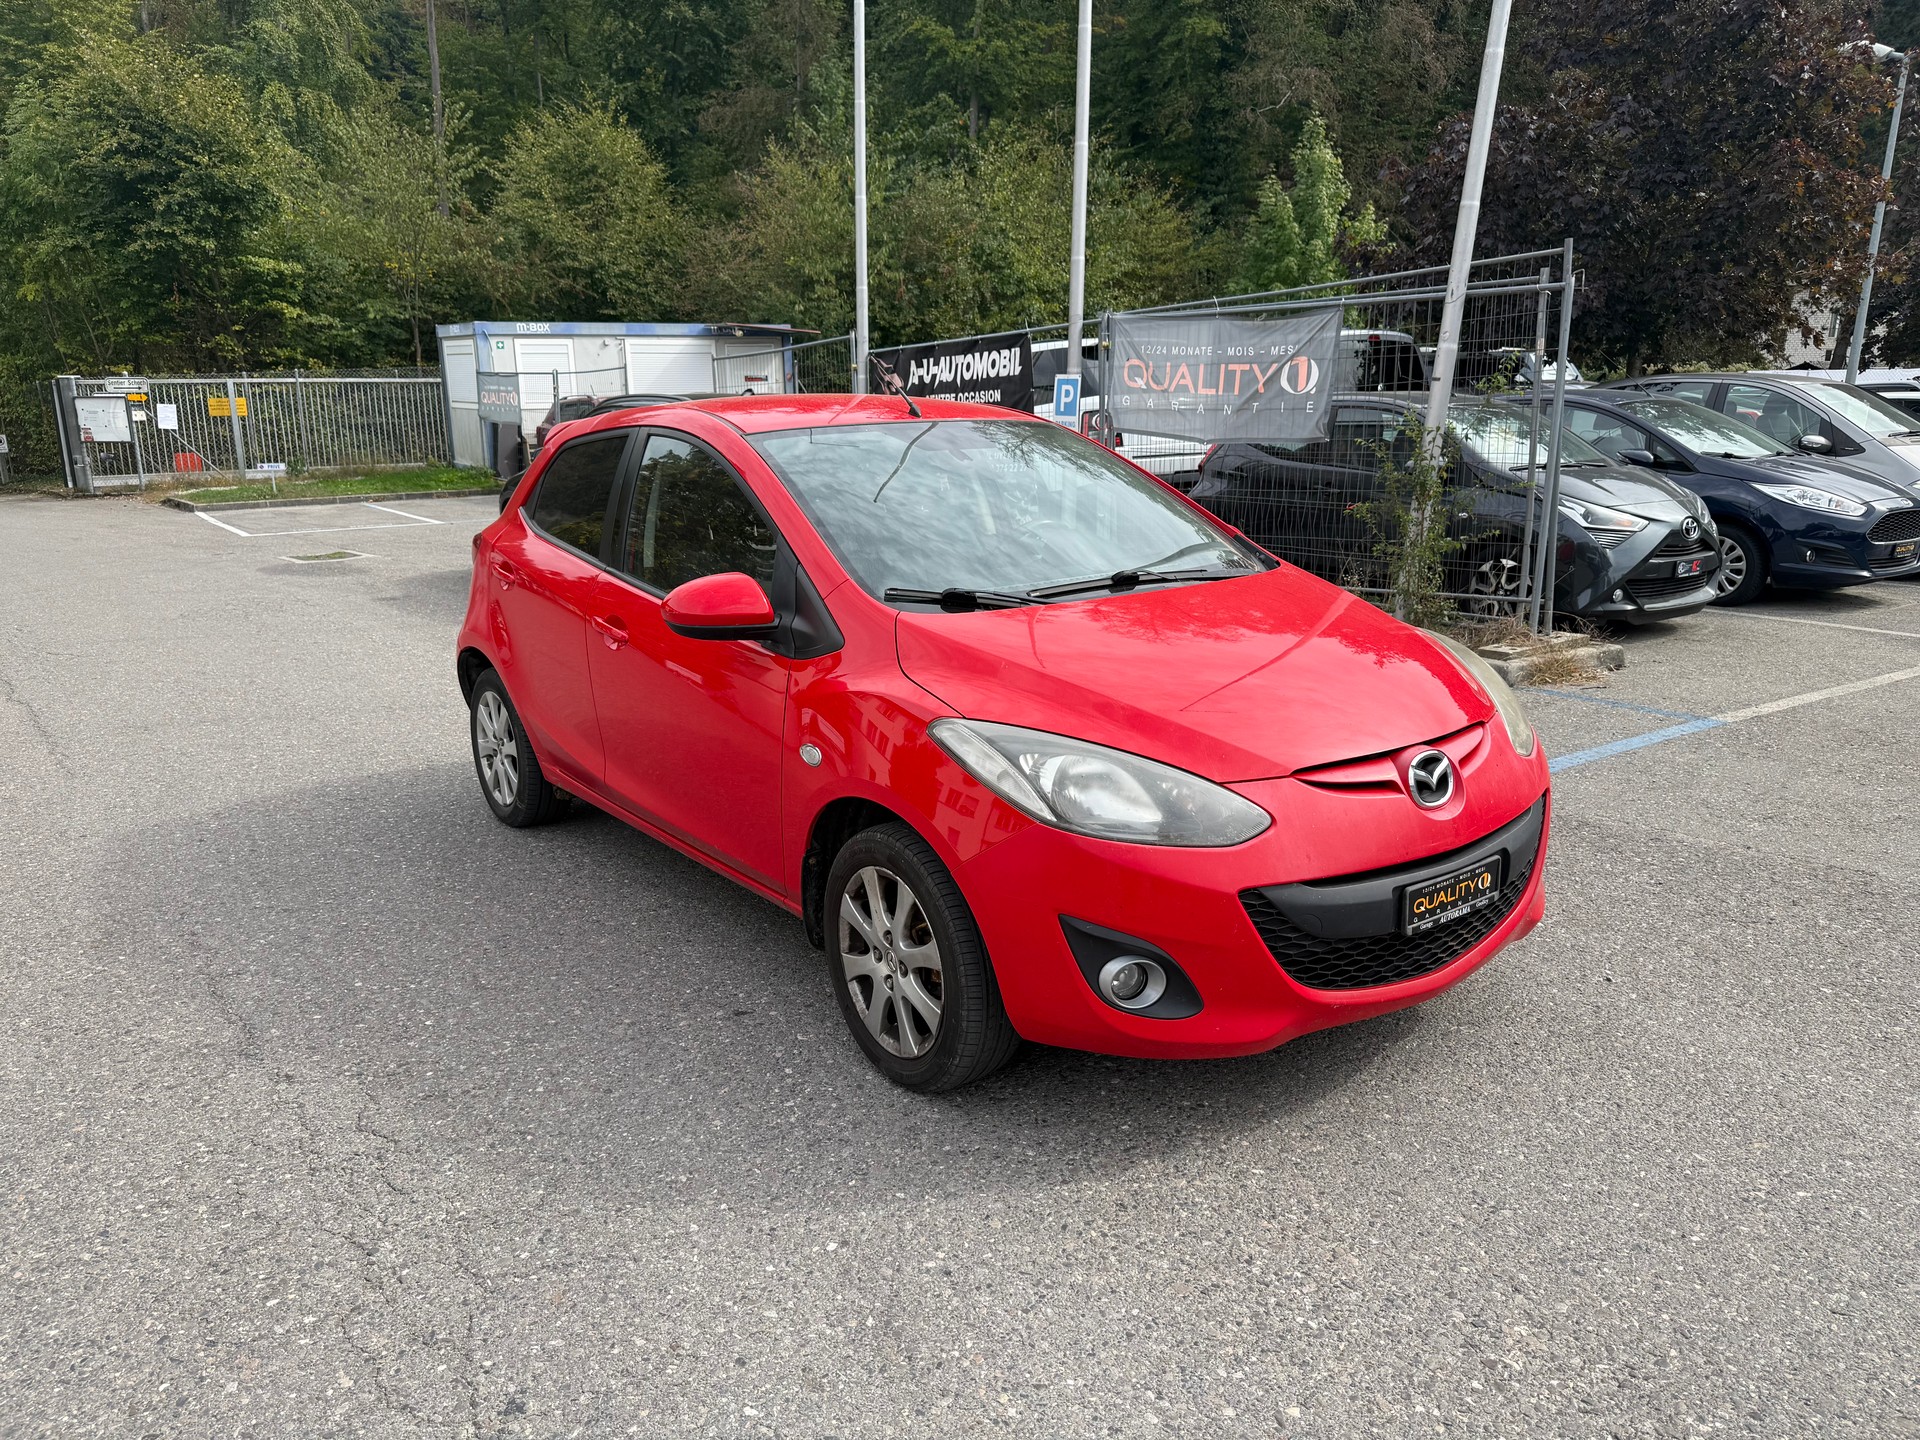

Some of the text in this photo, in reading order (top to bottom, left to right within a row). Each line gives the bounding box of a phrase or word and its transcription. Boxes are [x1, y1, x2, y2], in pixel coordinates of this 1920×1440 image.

[1140, 344, 1168, 355] 12/24
[1171, 346, 1213, 356] MONATE
[1227, 346, 1255, 356] MOIS
[906, 347, 1023, 391] A-U-AUTOMOBIL
[1123, 357, 1279, 396] QUALITY
[957, 389, 1001, 403] OCCASION
[1060, 385, 1075, 412] P
[1122, 395, 1314, 416] GARANTIE
[1413, 877, 1478, 914] QUALITY
[1413, 889, 1490, 923] GARANTIE
[1439, 905, 1471, 924] AUTORAMA
